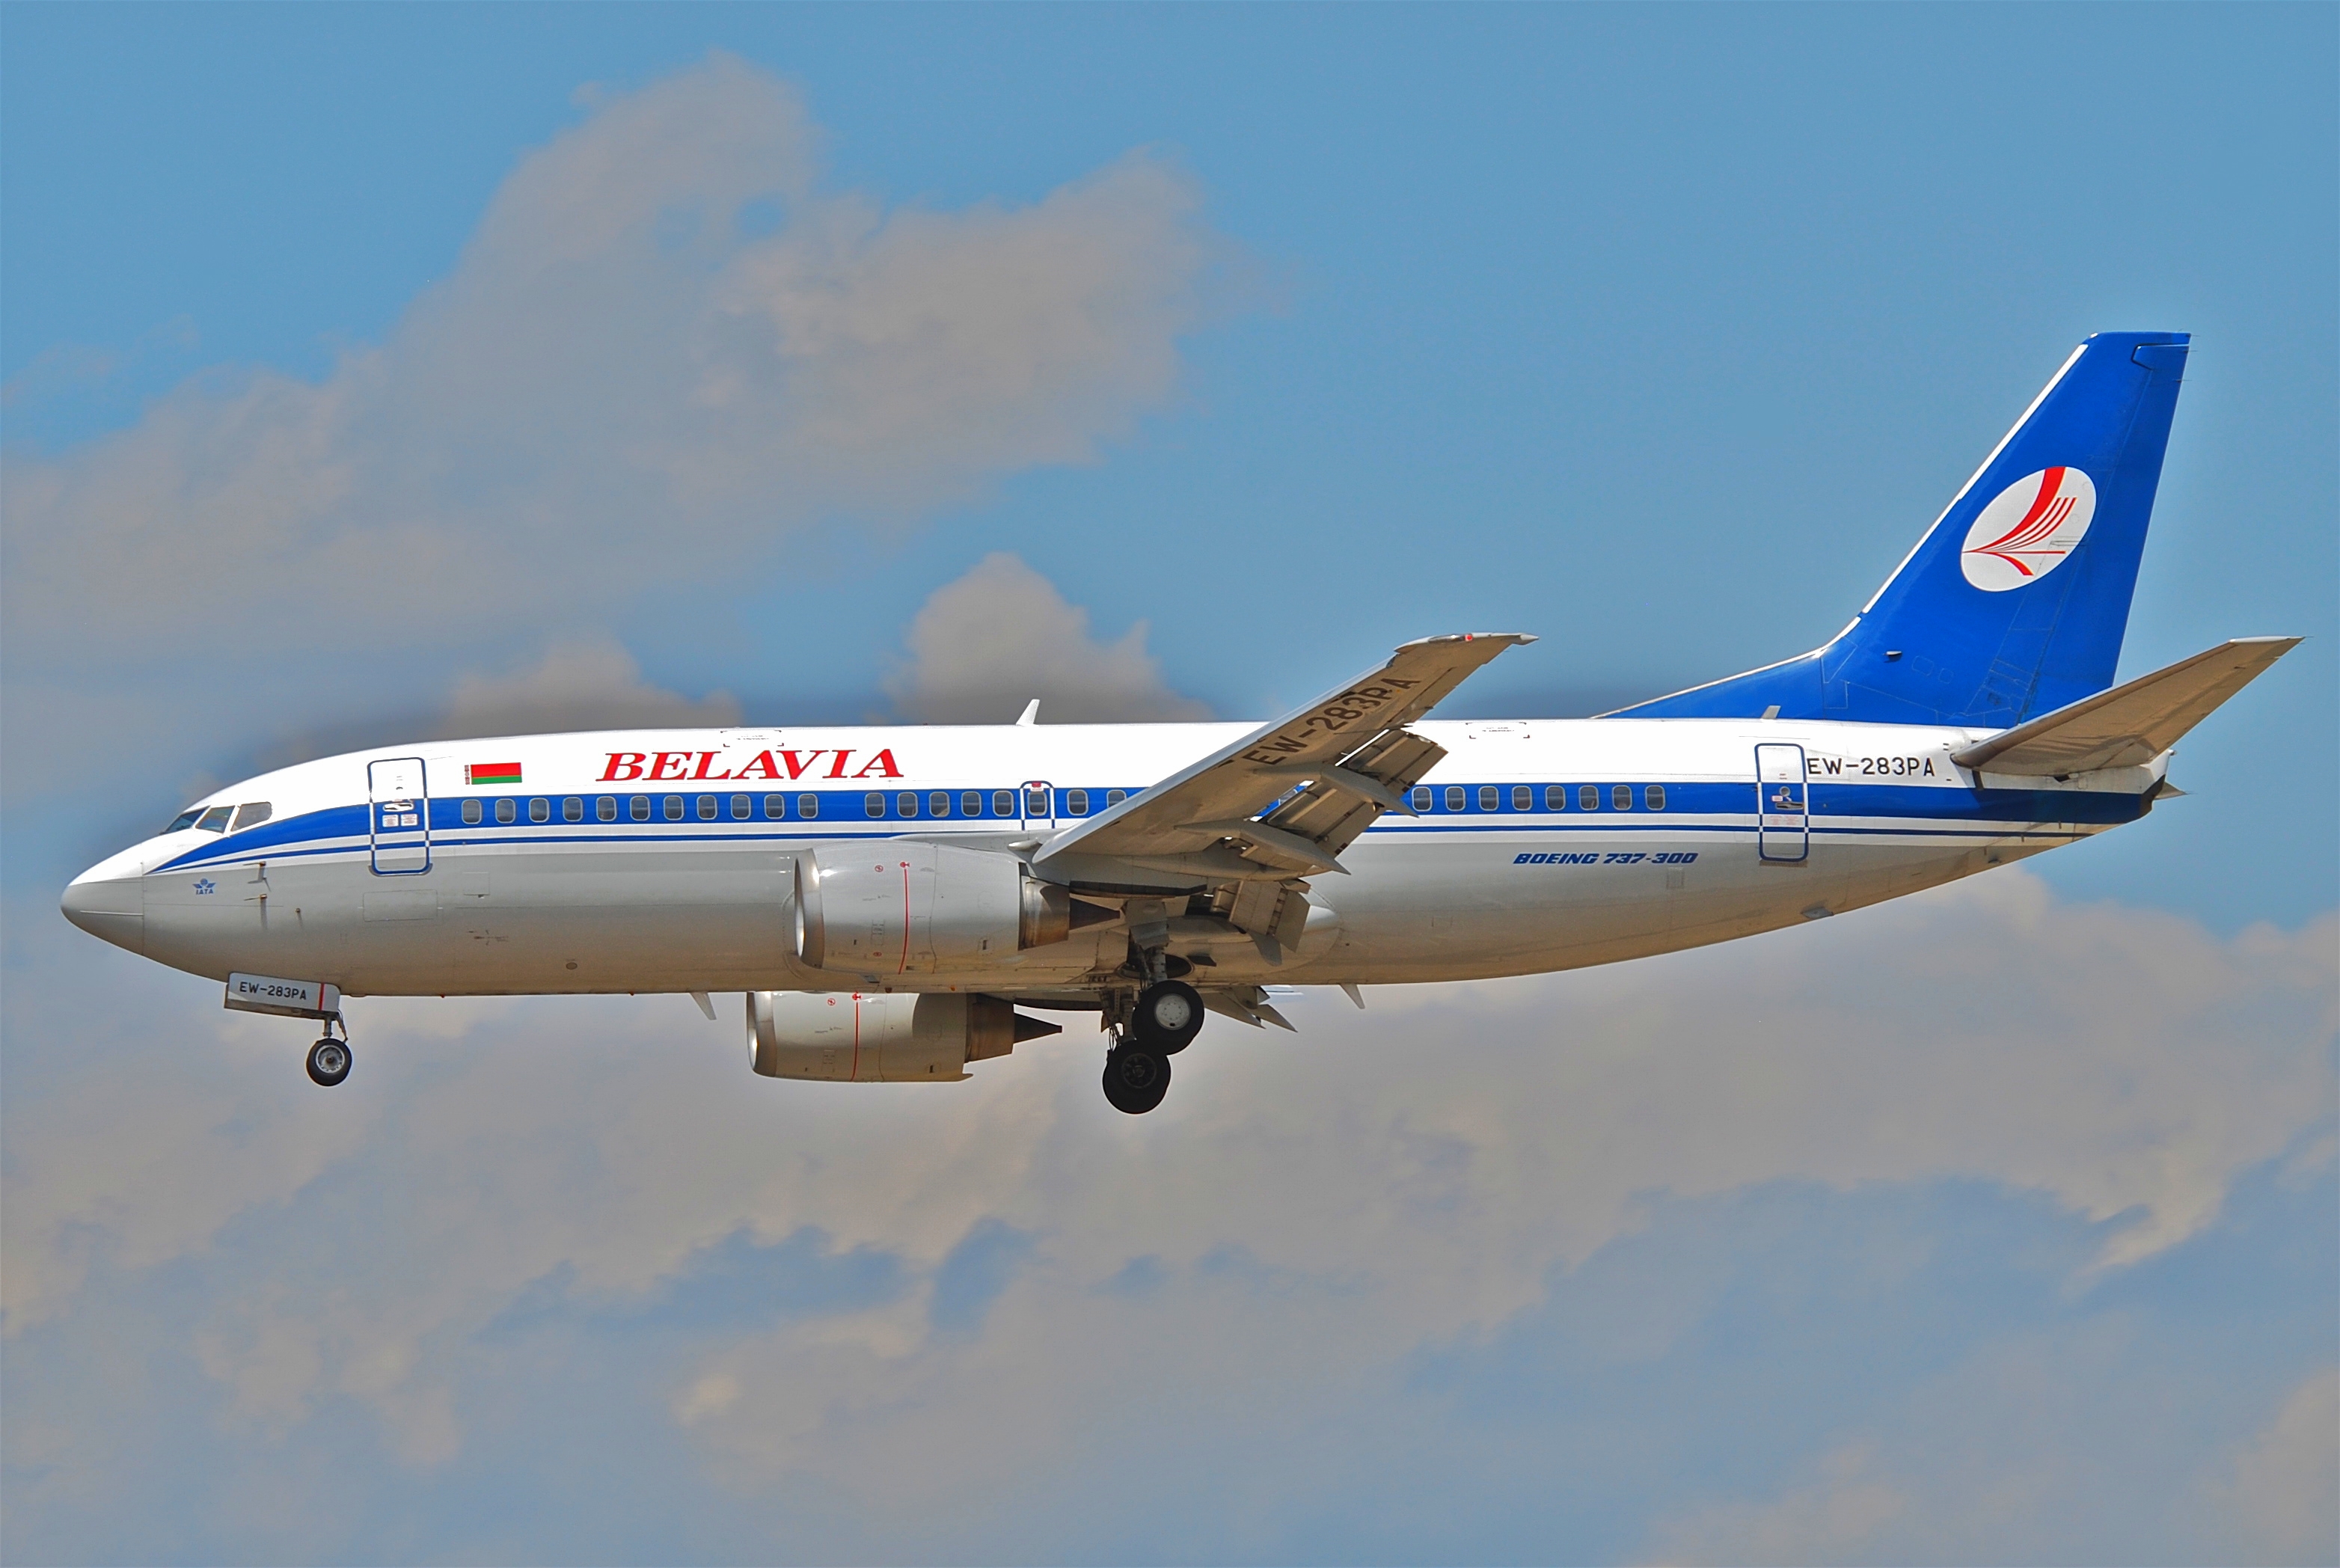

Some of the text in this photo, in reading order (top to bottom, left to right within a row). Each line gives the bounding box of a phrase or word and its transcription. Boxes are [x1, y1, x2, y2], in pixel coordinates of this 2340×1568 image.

[1242, 678, 1422, 765] EW-283PA
[595, 749, 904, 782] BELAVIA
[1807, 756, 1935, 777] EW-283PA
[1513, 852, 1698, 865] BOEING 737-300
[239, 981, 307, 1001] EW-283PA
